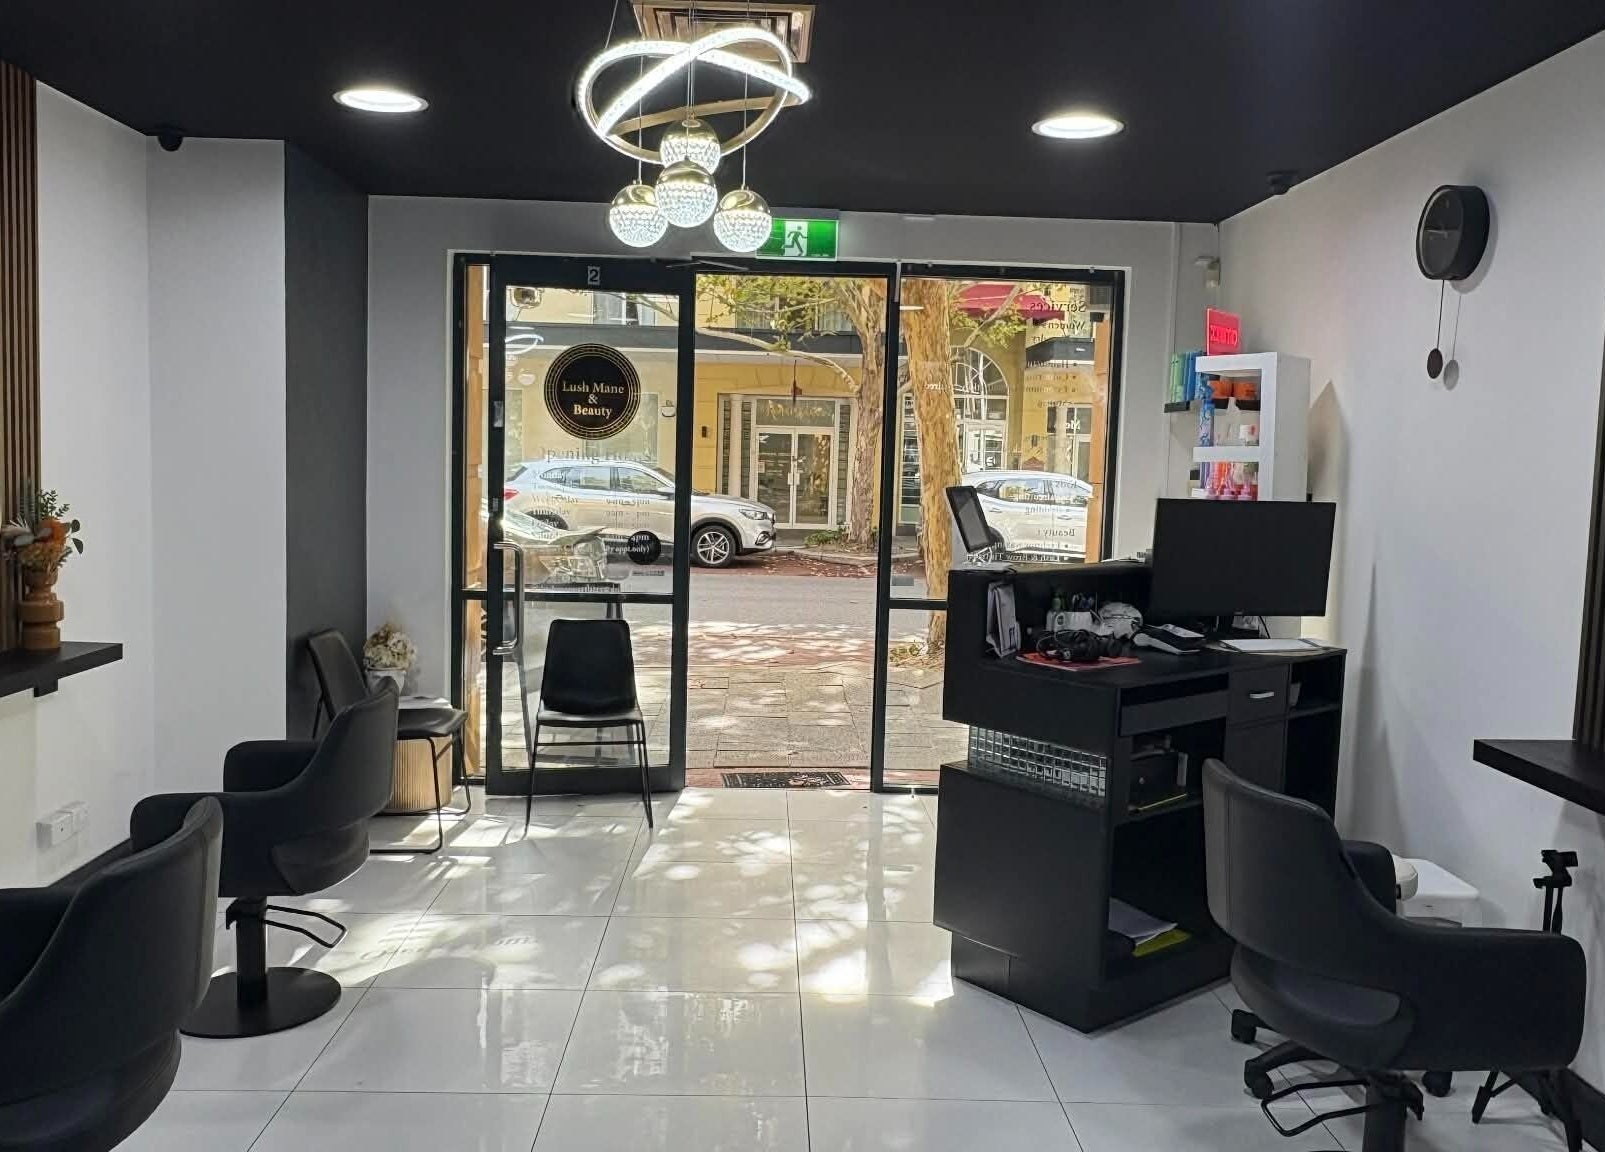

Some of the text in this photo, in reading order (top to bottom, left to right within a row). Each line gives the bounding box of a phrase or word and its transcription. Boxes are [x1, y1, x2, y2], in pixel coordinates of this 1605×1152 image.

[589, 268, 599, 282] 2
[562, 380, 625, 394] Lush Mane
[588, 393, 599, 405] &
[573, 404, 613, 419] Beauty
